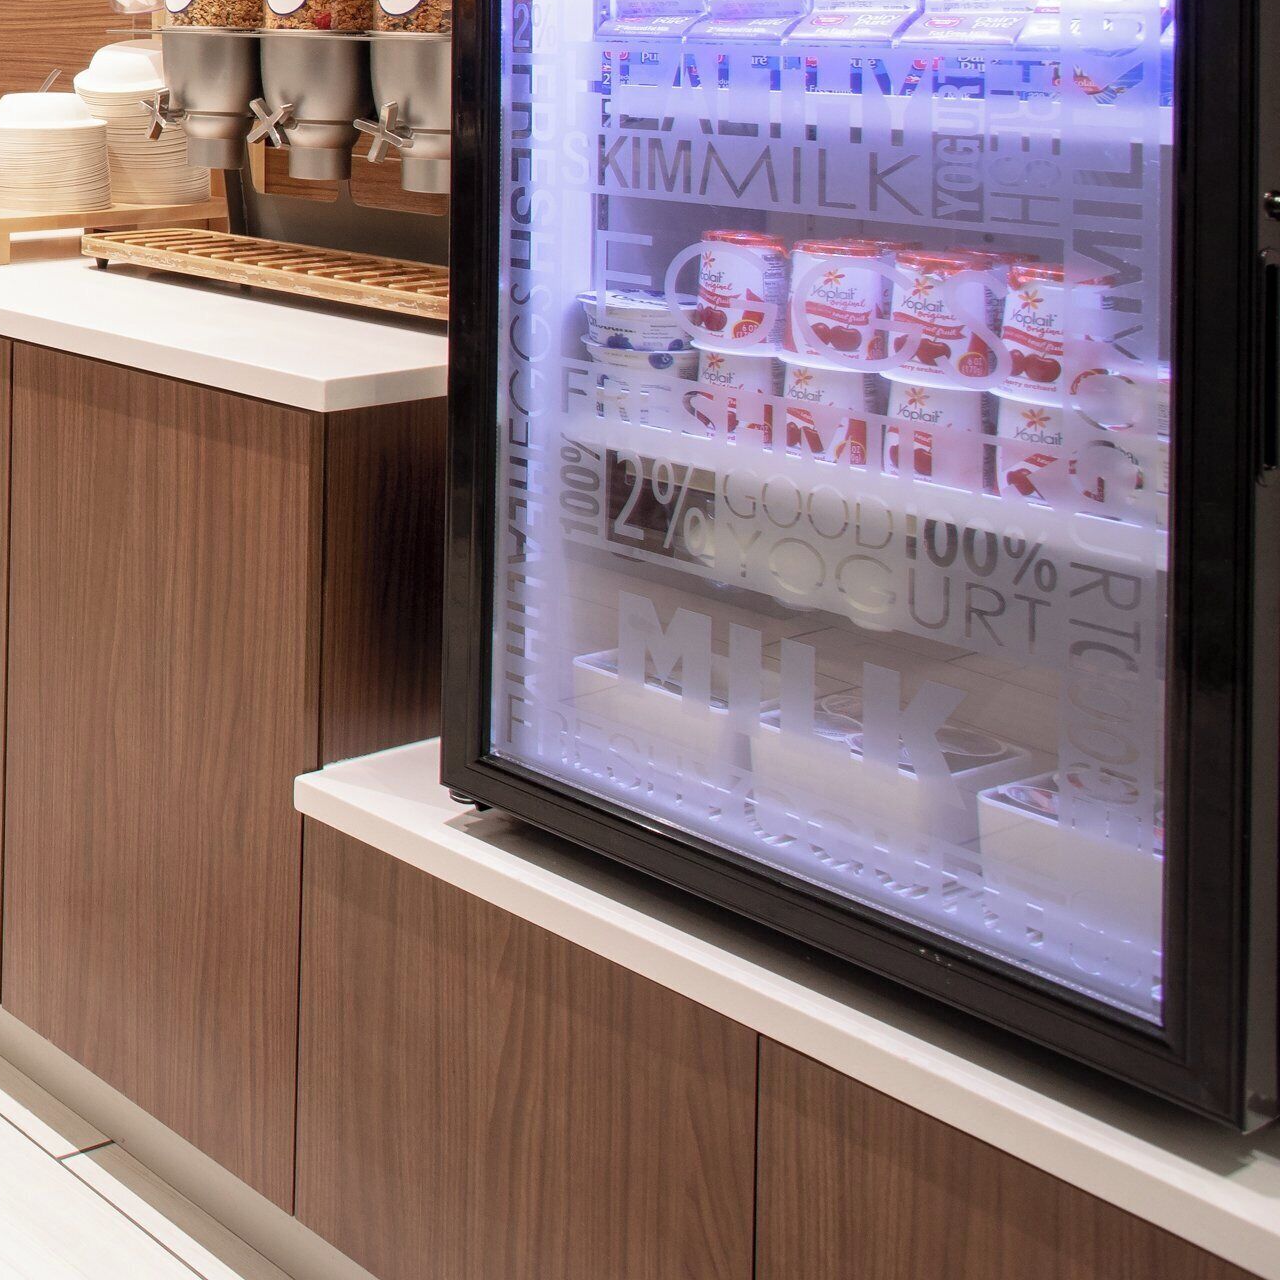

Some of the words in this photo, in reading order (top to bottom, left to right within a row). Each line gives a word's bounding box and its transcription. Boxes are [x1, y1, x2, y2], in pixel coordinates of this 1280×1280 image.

[566, 51, 927, 146] HEALTHY
[511, 63, 556, 269] FRESH
[563, 131, 691, 194] SKIM
[699, 140, 924, 217] MILK
[597, 229, 1013, 391] EGGS
[811, 285, 856, 301] Yoplait
[901, 294, 944, 313] Yoplait
[1010, 307, 1055, 327] Yoplait
[509, 283, 552, 448] EGGS
[702, 368, 734, 385] Yoplait
[787, 386, 824, 403] Yoplait
[897, 403, 942, 423] Yoplait
[559, 431, 601, 538] 100%
[1013, 427, 1062, 446] Yoplait
[614, 453, 707, 556] 2%
[723, 467, 894, 550] GOOD
[905, 503, 1058, 593] 100%
[1069, 324, 1144, 654] YOGURT
[726, 521, 1053, 655] YOGURT
[618, 590, 970, 812] MILK
